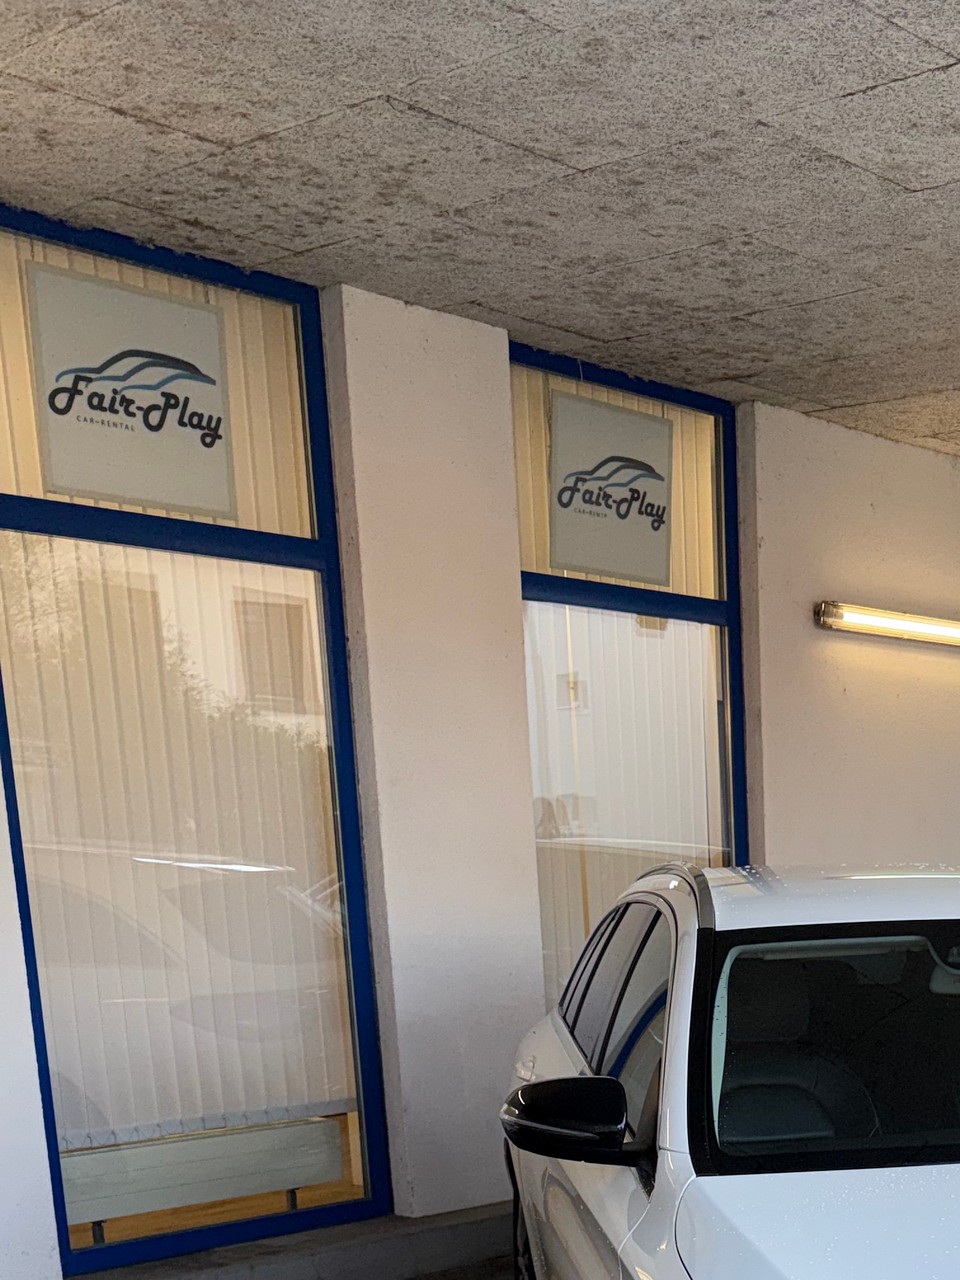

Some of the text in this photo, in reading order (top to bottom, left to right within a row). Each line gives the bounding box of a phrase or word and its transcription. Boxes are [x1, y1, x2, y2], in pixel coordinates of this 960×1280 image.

[48, 374, 223, 448] Fair-Play
[76, 415, 136, 432] CAR-RENTAL
[557, 477, 667, 532] Fair-Play
[573, 507, 609, 519] CAR-RENTA
